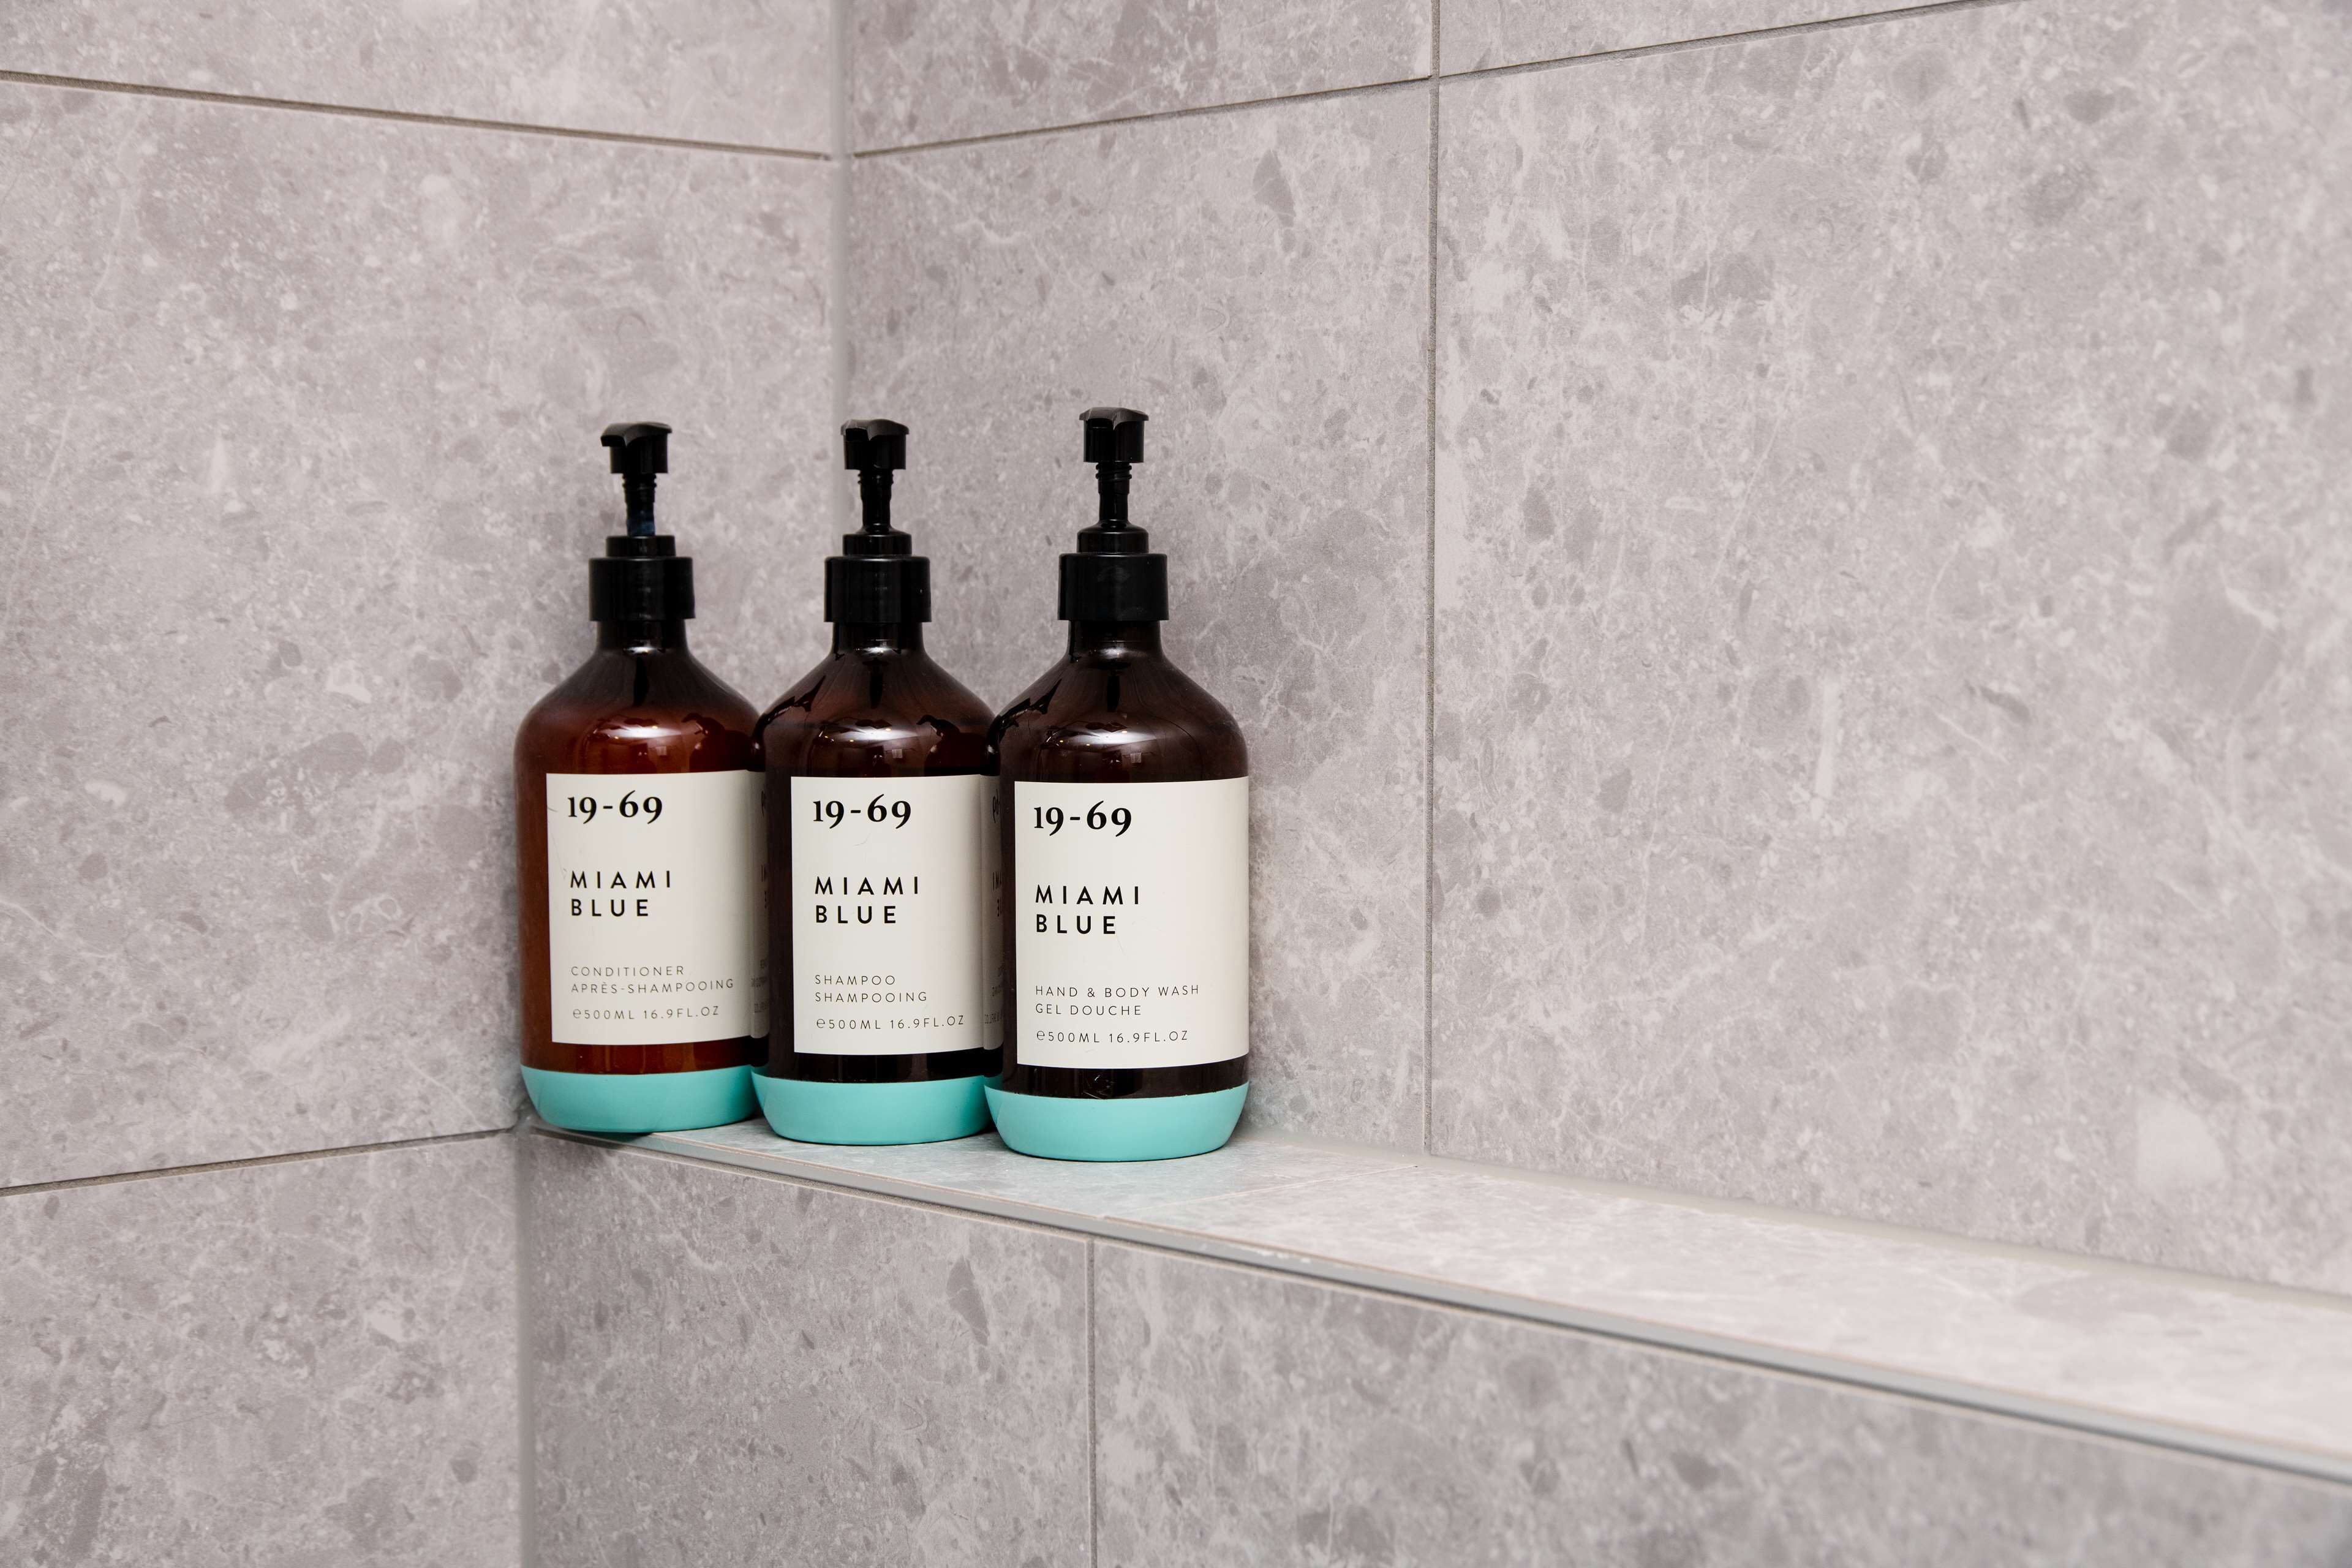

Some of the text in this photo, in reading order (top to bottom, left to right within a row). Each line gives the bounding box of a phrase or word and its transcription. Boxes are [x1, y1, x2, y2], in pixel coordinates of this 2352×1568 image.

[567, 790, 663, 824] 19-69
[813, 793, 911, 829] 19-69
[1033, 800, 1132, 837] 19-69
[570, 870, 671, 889] MIAMI
[815, 876, 918, 895] MIAMI
[1035, 884, 1139, 905] MIAMI
[570, 899, 649, 917] BLUE
[815, 905, 897, 924] BLUE
[1036, 914, 1116, 935] BLUE
[570, 965, 684, 977] CONDITIONER
[571, 978, 734, 994] APRÈS-SHAMPOOING
[815, 974, 895, 986] SHAMPOO
[815, 991, 927, 1003] SHAMPOOING
[1035, 984, 1199, 998] HAND & BODY WASH
[643, 1005, 720, 1020] 16.9FL.OZ
[1035, 1003, 1142, 1016] GEL DOUCHE
[890, 1014, 964, 1030] 16.9FL.OZ
[1109, 1030, 1188, 1044] 16.9FL.OZ
